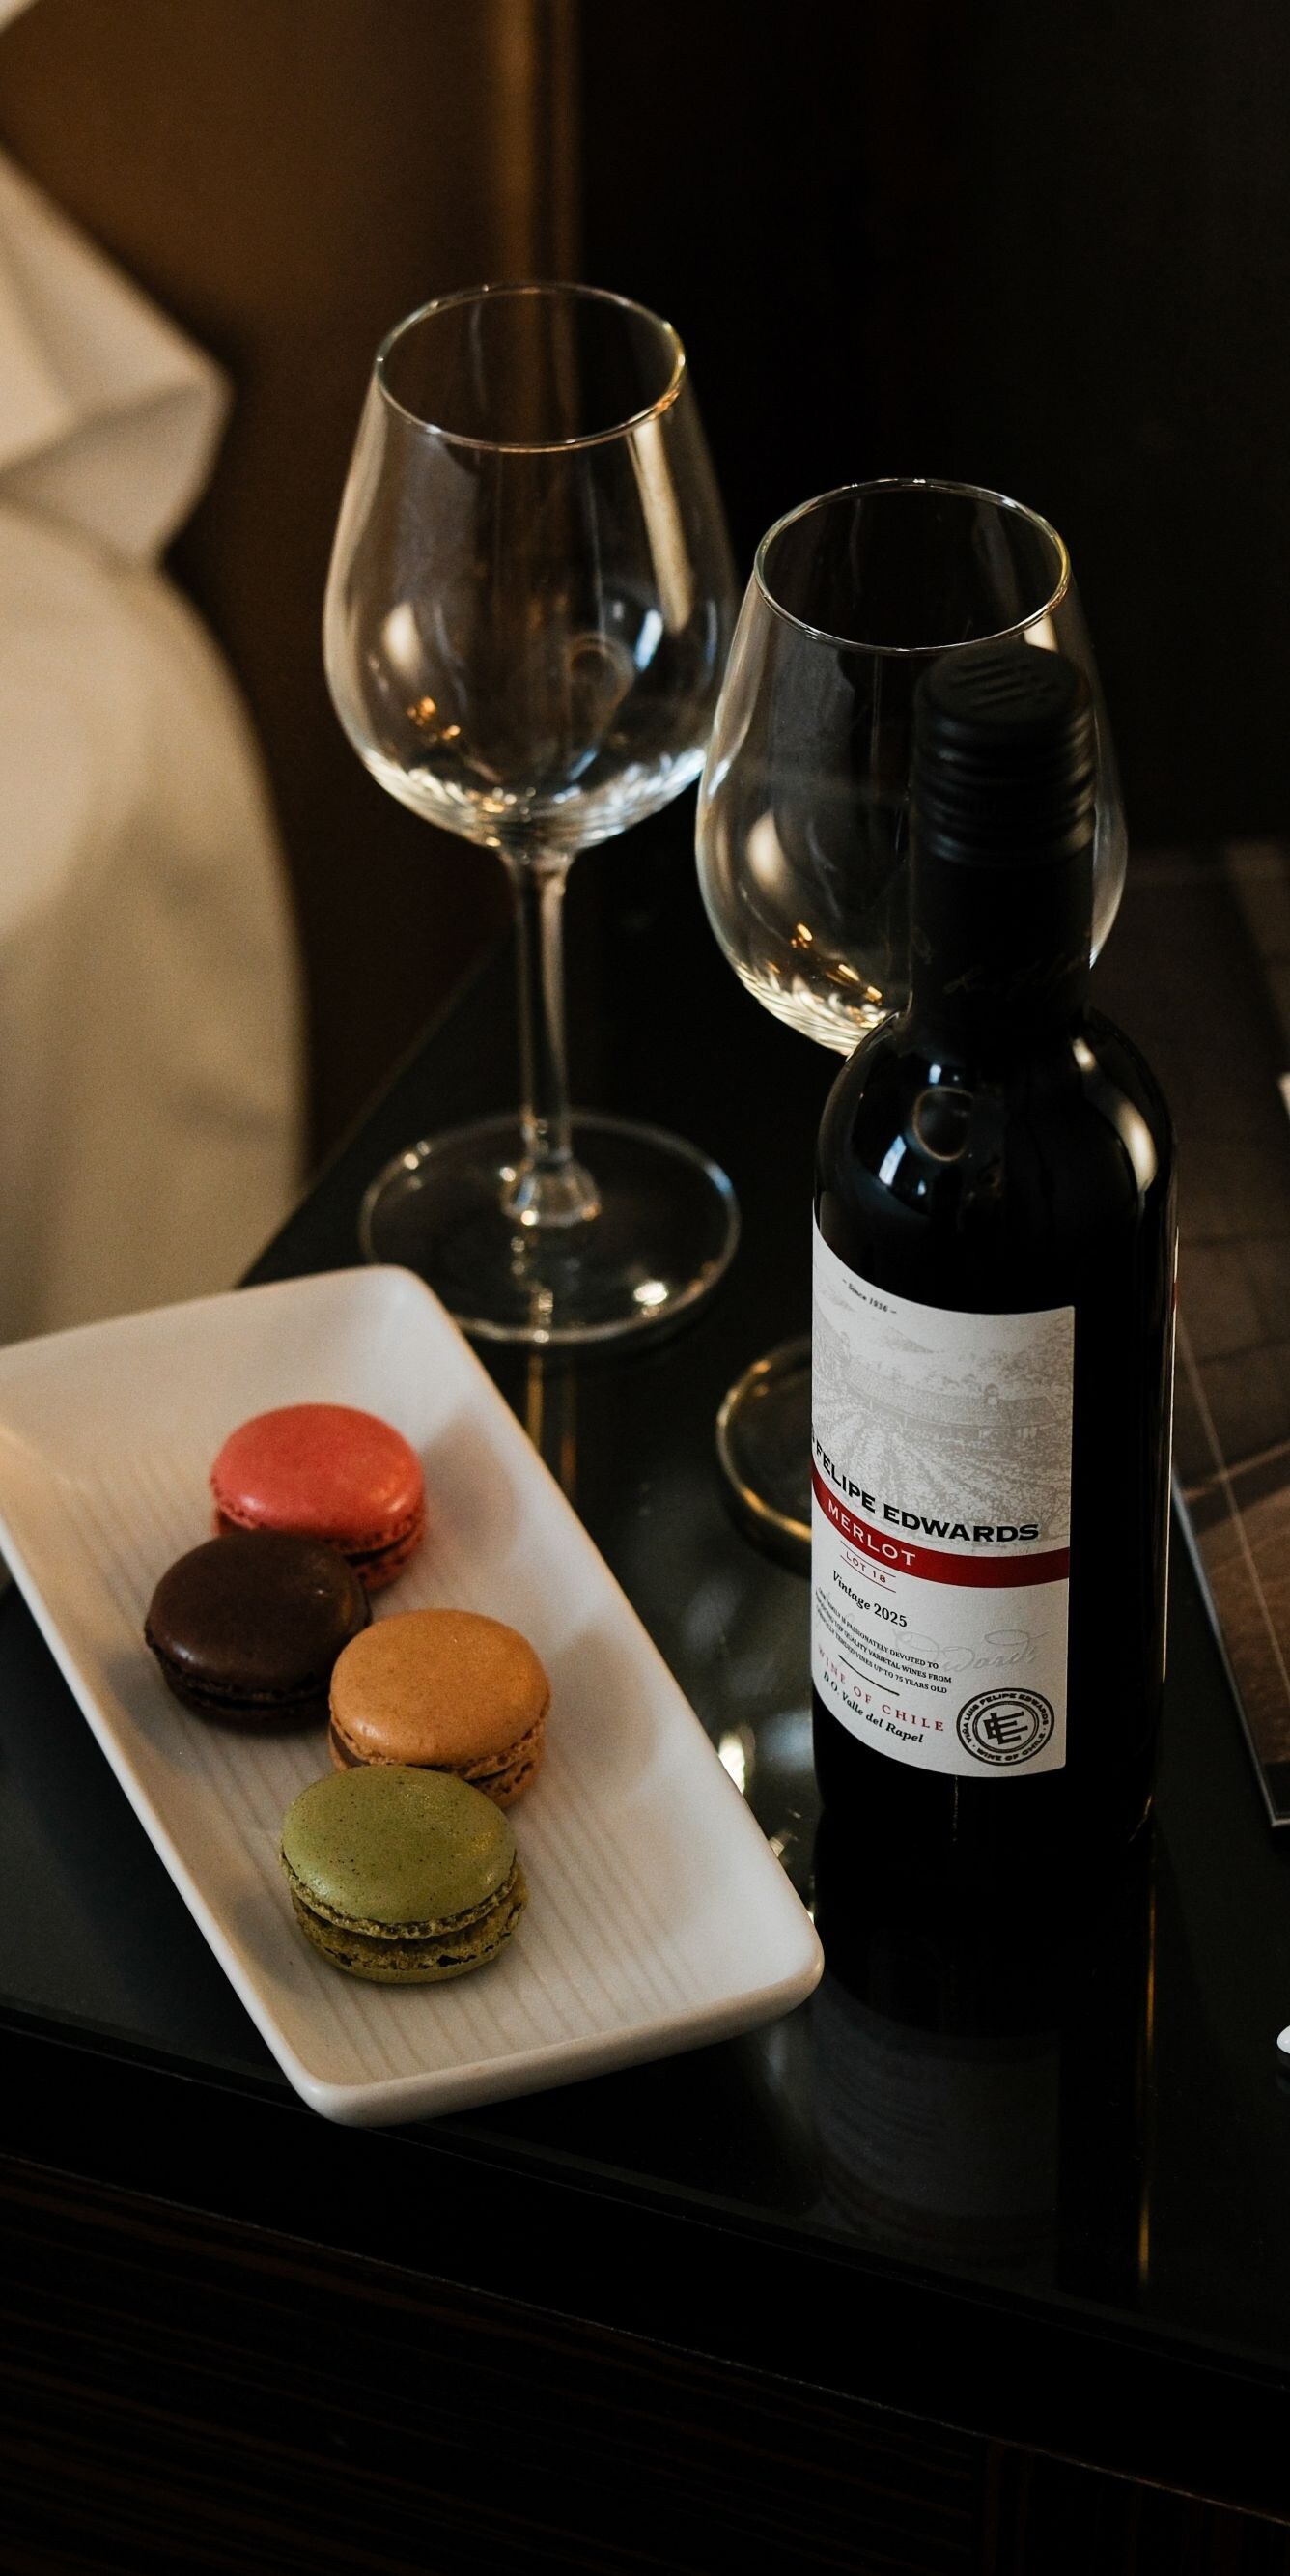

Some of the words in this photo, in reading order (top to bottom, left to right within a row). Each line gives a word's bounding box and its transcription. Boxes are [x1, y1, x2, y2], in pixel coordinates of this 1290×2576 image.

[816, 1439, 876, 1514] FELIPE
[883, 1502, 1039, 1543] EDWARDS
[828, 1498, 916, 1566] MERLOT
[846, 1551, 866, 1571] LOT
[872, 1571, 886, 1583] 18
[832, 1570, 871, 1610] Vintage
[873, 1602, 908, 1628] 2025
[844, 1630, 869, 1653] QUALITY
[868, 1649, 901, 1670] VARIETAL
[901, 1664, 927, 1679] WINES
[928, 1673, 952, 1684] FROM
[846, 1621, 889, 1653] PASSIONATELY
[889, 1649, 926, 1667] DEVOTED
[927, 1660, 939, 1670] TO
[818, 1643, 846, 1685] WINE
[853, 1685, 872, 1704] OF
[882, 1704, 944, 1732] CHILE
[855, 1651, 874, 1668] VINES
[873, 1663, 883, 1673] UP
[883, 1669, 894, 1679] TO
[904, 1677, 929, 1690] YEARS
[930, 1684, 947, 1694] OLD
[842, 1691, 864, 1716] Valle
[865, 1713, 883, 1728] del
[886, 1721, 924, 1743] Rapel
[965, 1704, 980, 1721] LUIS
[979, 1693, 1017, 1706] FELIPE
[1019, 1694, 1050, 1726] EDWARDS
[977, 1748, 1002, 1761] WINE
[1022, 1733, 1045, 1756] CHILE
